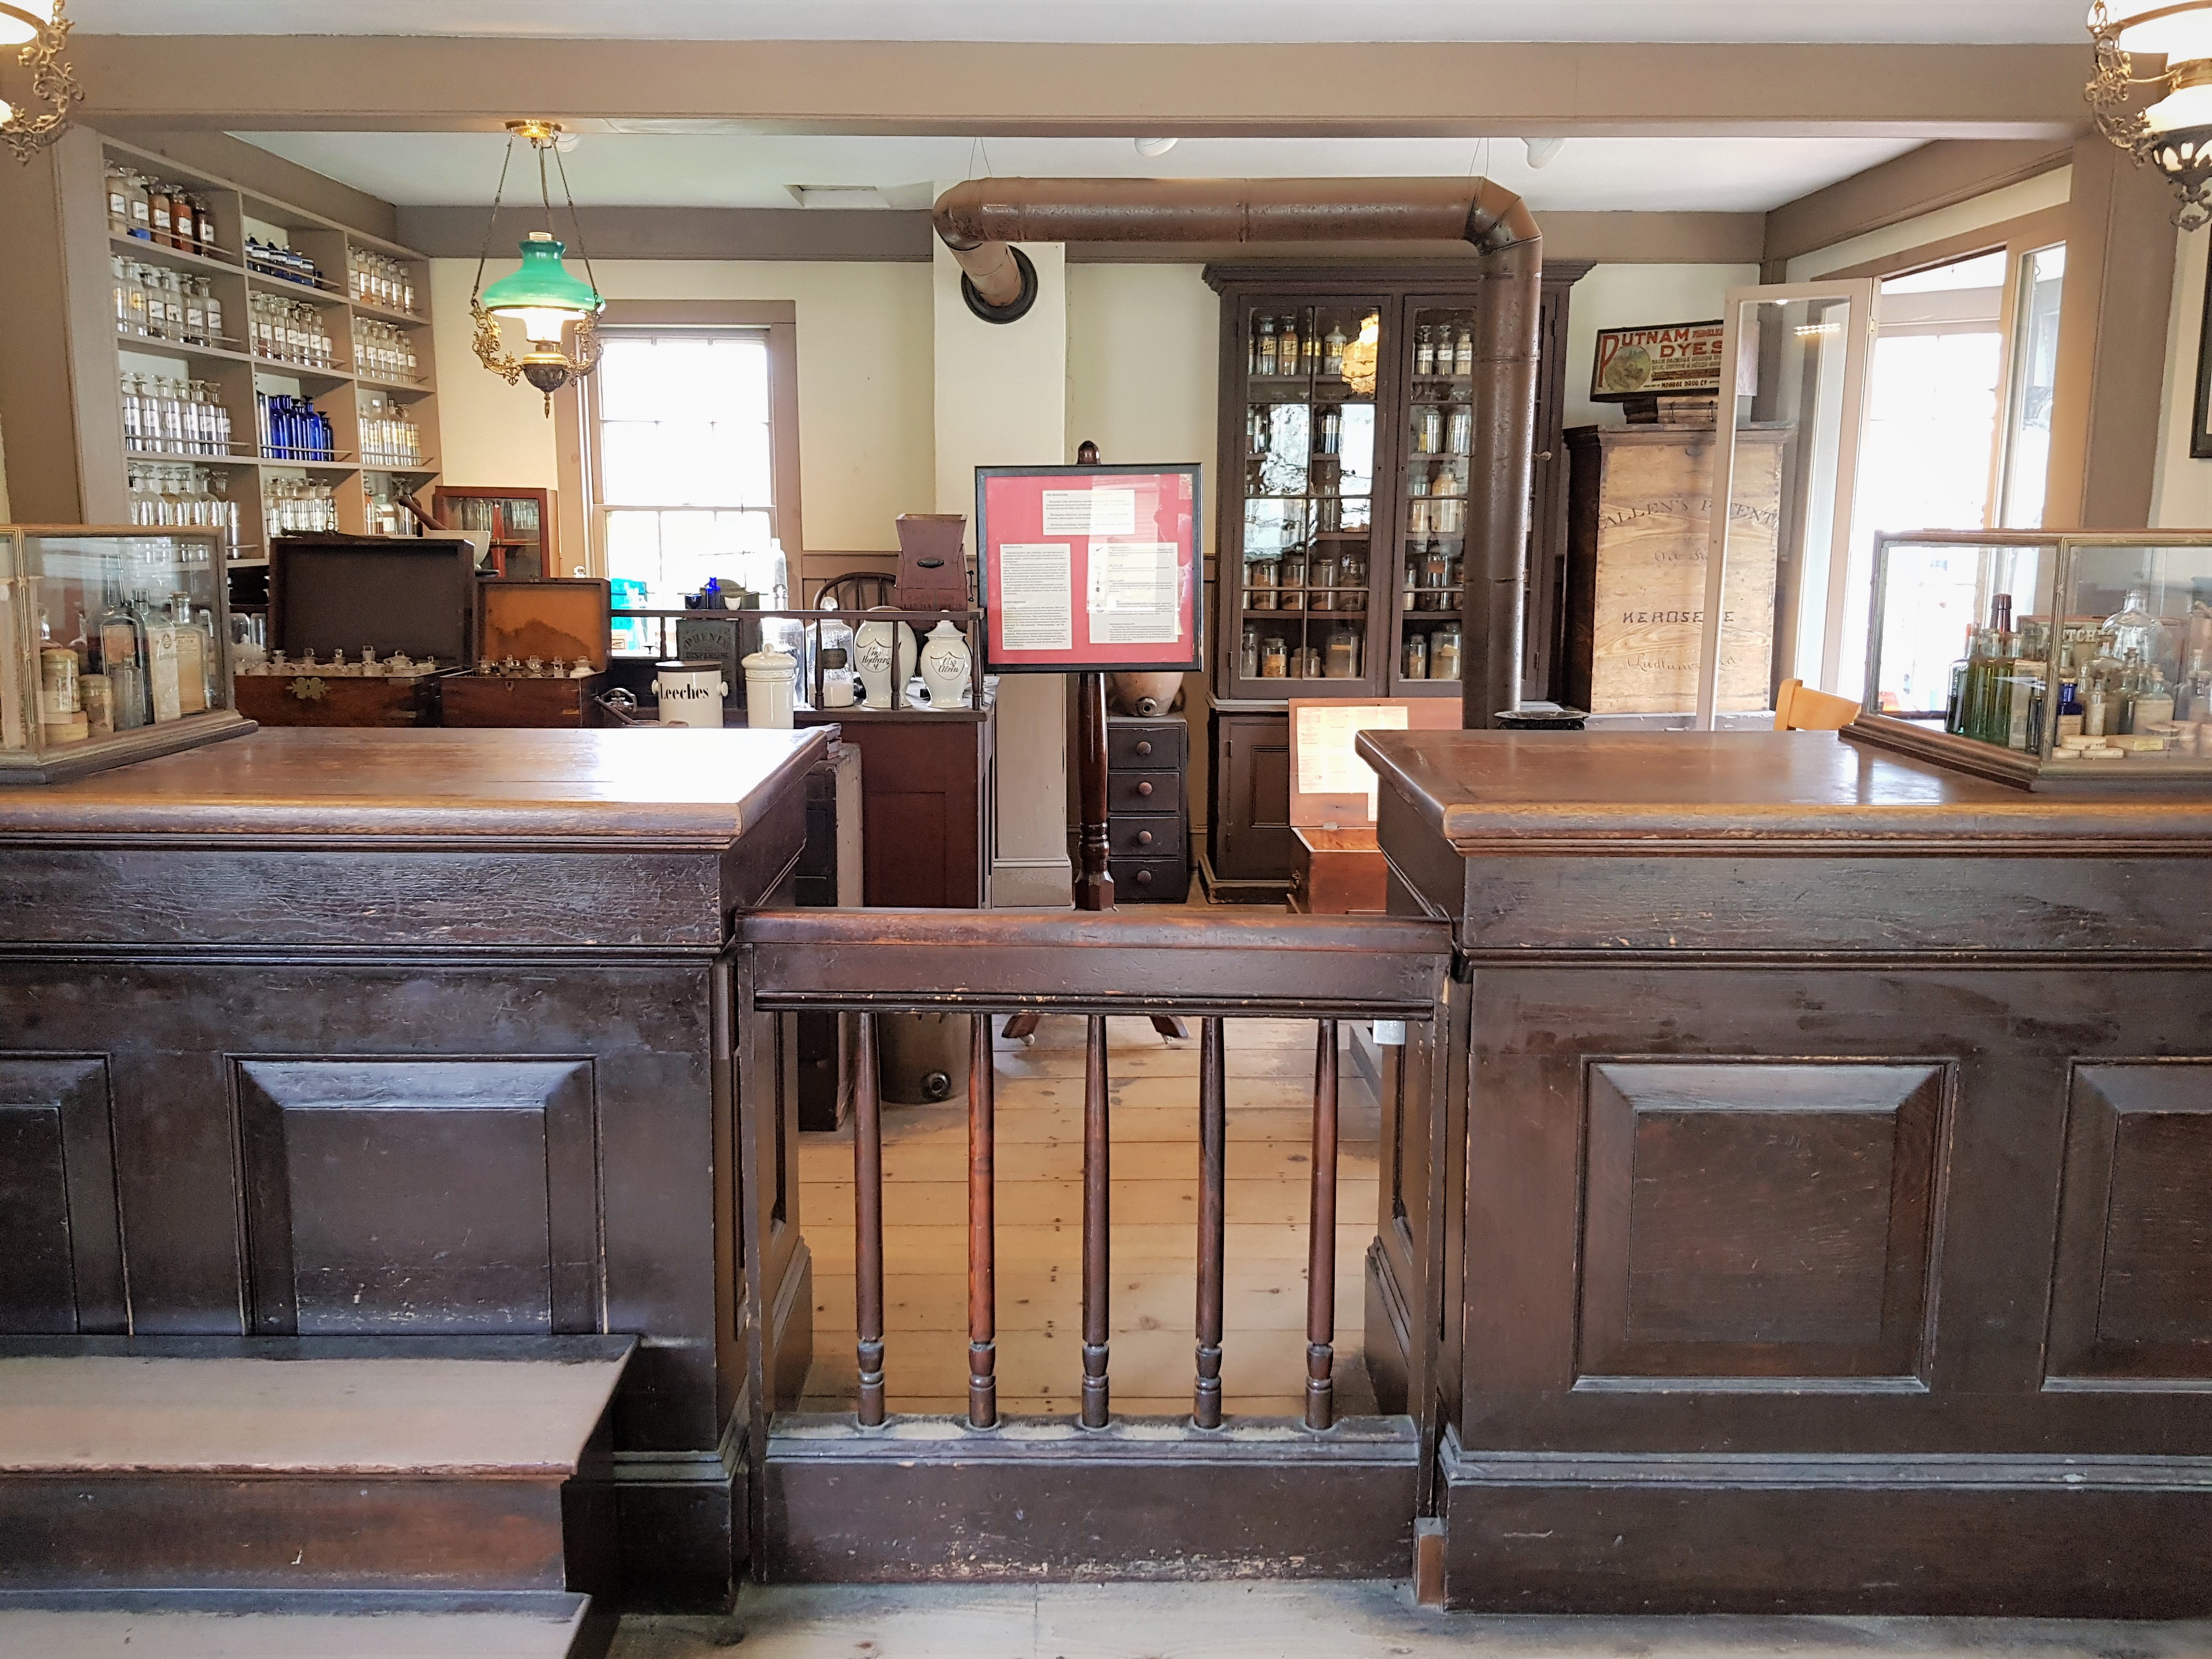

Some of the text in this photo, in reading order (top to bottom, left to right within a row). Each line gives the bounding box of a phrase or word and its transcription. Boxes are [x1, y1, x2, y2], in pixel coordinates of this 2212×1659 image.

[1660, 340, 1723, 357] DYES
[1598, 329, 1689, 387] PUTNAM
[1606, 499, 1772, 526] ALLEN'S PTENT
[1623, 611, 1735, 623] KEROSEE
[660, 683, 709, 699] Leeches
